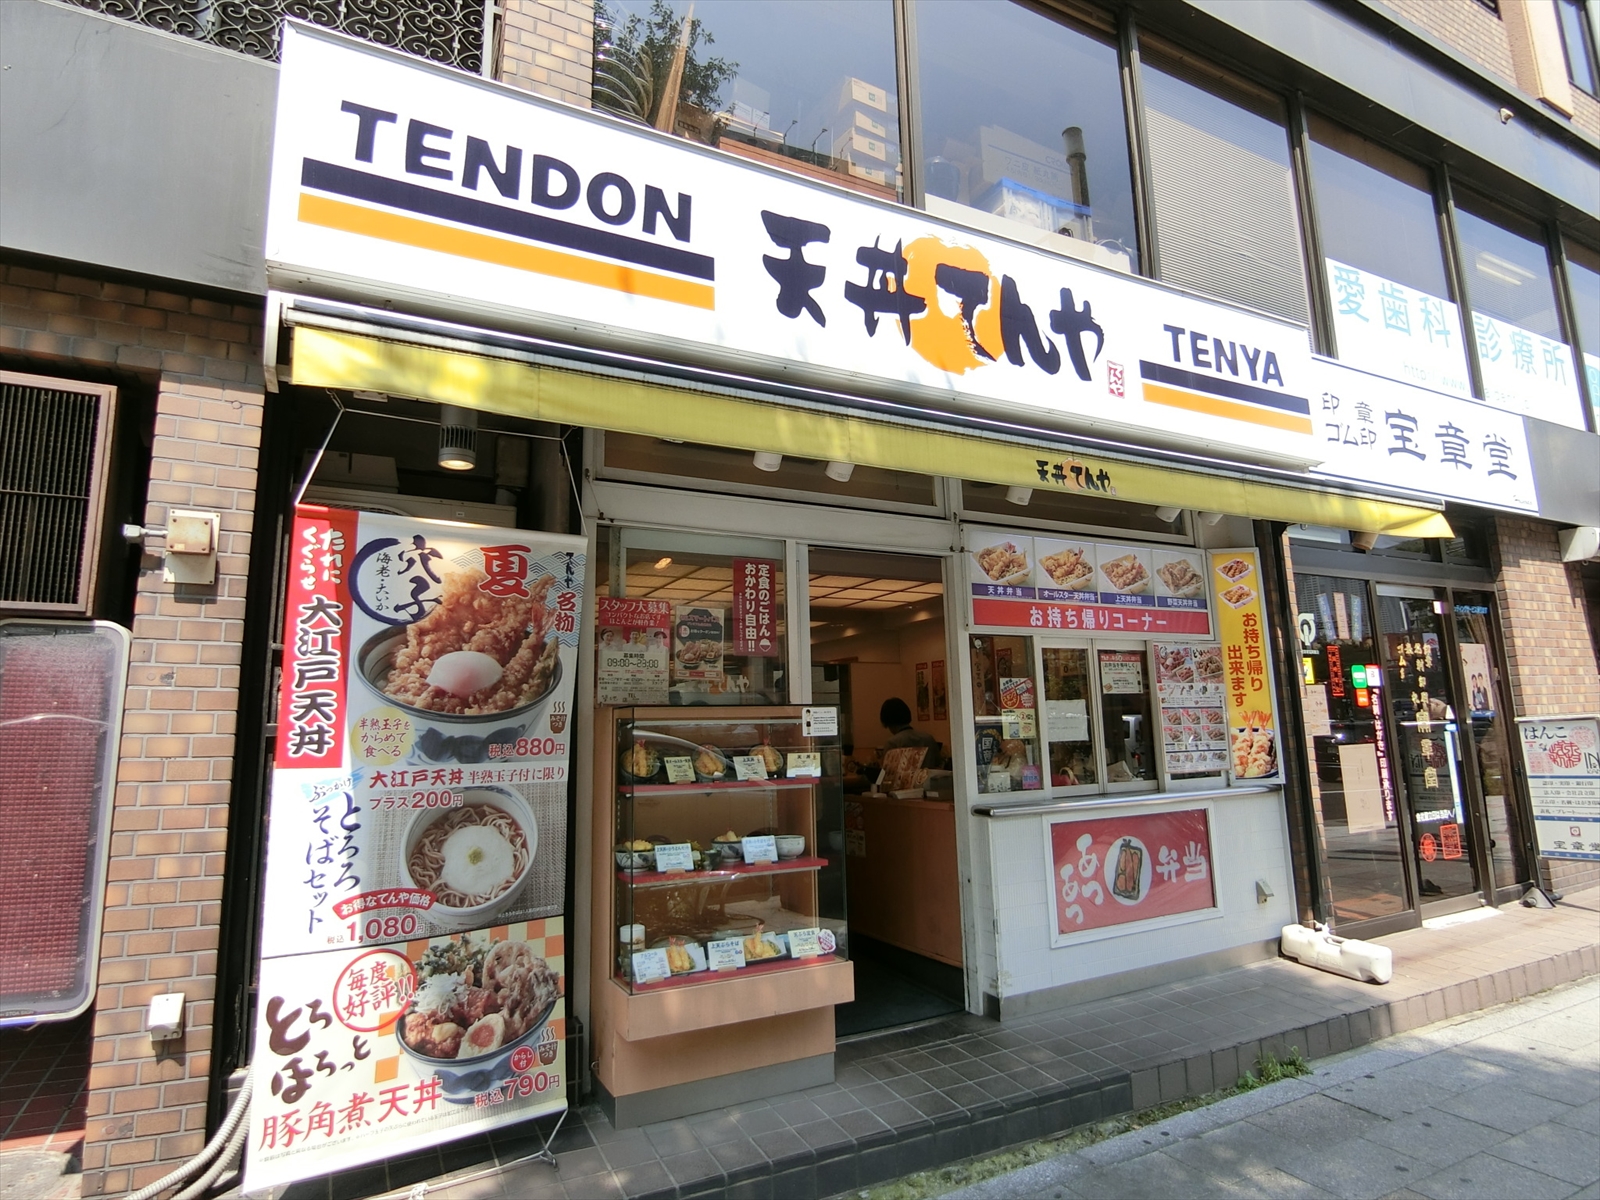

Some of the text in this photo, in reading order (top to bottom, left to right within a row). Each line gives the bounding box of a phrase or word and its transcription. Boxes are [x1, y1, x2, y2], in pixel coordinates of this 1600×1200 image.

[340, 100, 692, 243] TENDON
[761, 210, 1105, 382] 天丼てんや
[1334, 265, 1567, 386] 愛歯科 診療所
[1163, 323, 1285, 387] TENYA
[1322, 392, 1374, 423] 印章
[1325, 422, 1377, 450] ゴム印
[1385, 409, 1518, 481] 宝章堂
[1036, 459, 1111, 493] 天丼てんや
[300, 526, 318, 591] くぐらせ
[319, 527, 346, 584] たれに
[479, 544, 532, 598] 夏
[393, 534, 443, 621] 穴子
[987, 585, 1023, 597] 天丼弁当
[600, 599, 670, 614] スタッフ大募集
[744, 562, 758, 652] おかわり自由!!
[758, 563, 771, 637] 定食のごはん
[1042, 590, 1096, 601] オールスター天丼弁当
[1114, 595, 1142, 605] 上天丼弁当
[1029, 605, 1168, 631] お持ち帰りコーナー
[1242, 613, 1264, 692] お持ち帰り
[290, 595, 345, 757] 大江戸天丼
[1227, 644, 1248, 707] 出来ます
[358, 717, 411, 731] 半熟玉子を
[360, 731, 406, 744] からめて
[1524, 726, 1568, 740] はんこ
[363, 744, 402, 758] 食べる
[488, 737, 566, 758] 税込880円
[307, 777, 353, 802] ぶっかけ
[369, 765, 566, 789] 大江戸天丼 半熟玉子付に限り
[369, 789, 465, 810] プラス200円
[333, 791, 362, 892] とろろ
[303, 805, 339, 934] そばセット
[1155, 841, 1208, 883] 弁当
[340, 891, 432, 916] お得なてんや価格
[346, 961, 391, 992] 毎度
[519, 1060, 527, 1068] 付
[473, 1072, 560, 1108] 税込790円
[259, 1075, 443, 1151] 豚角煮天丼
